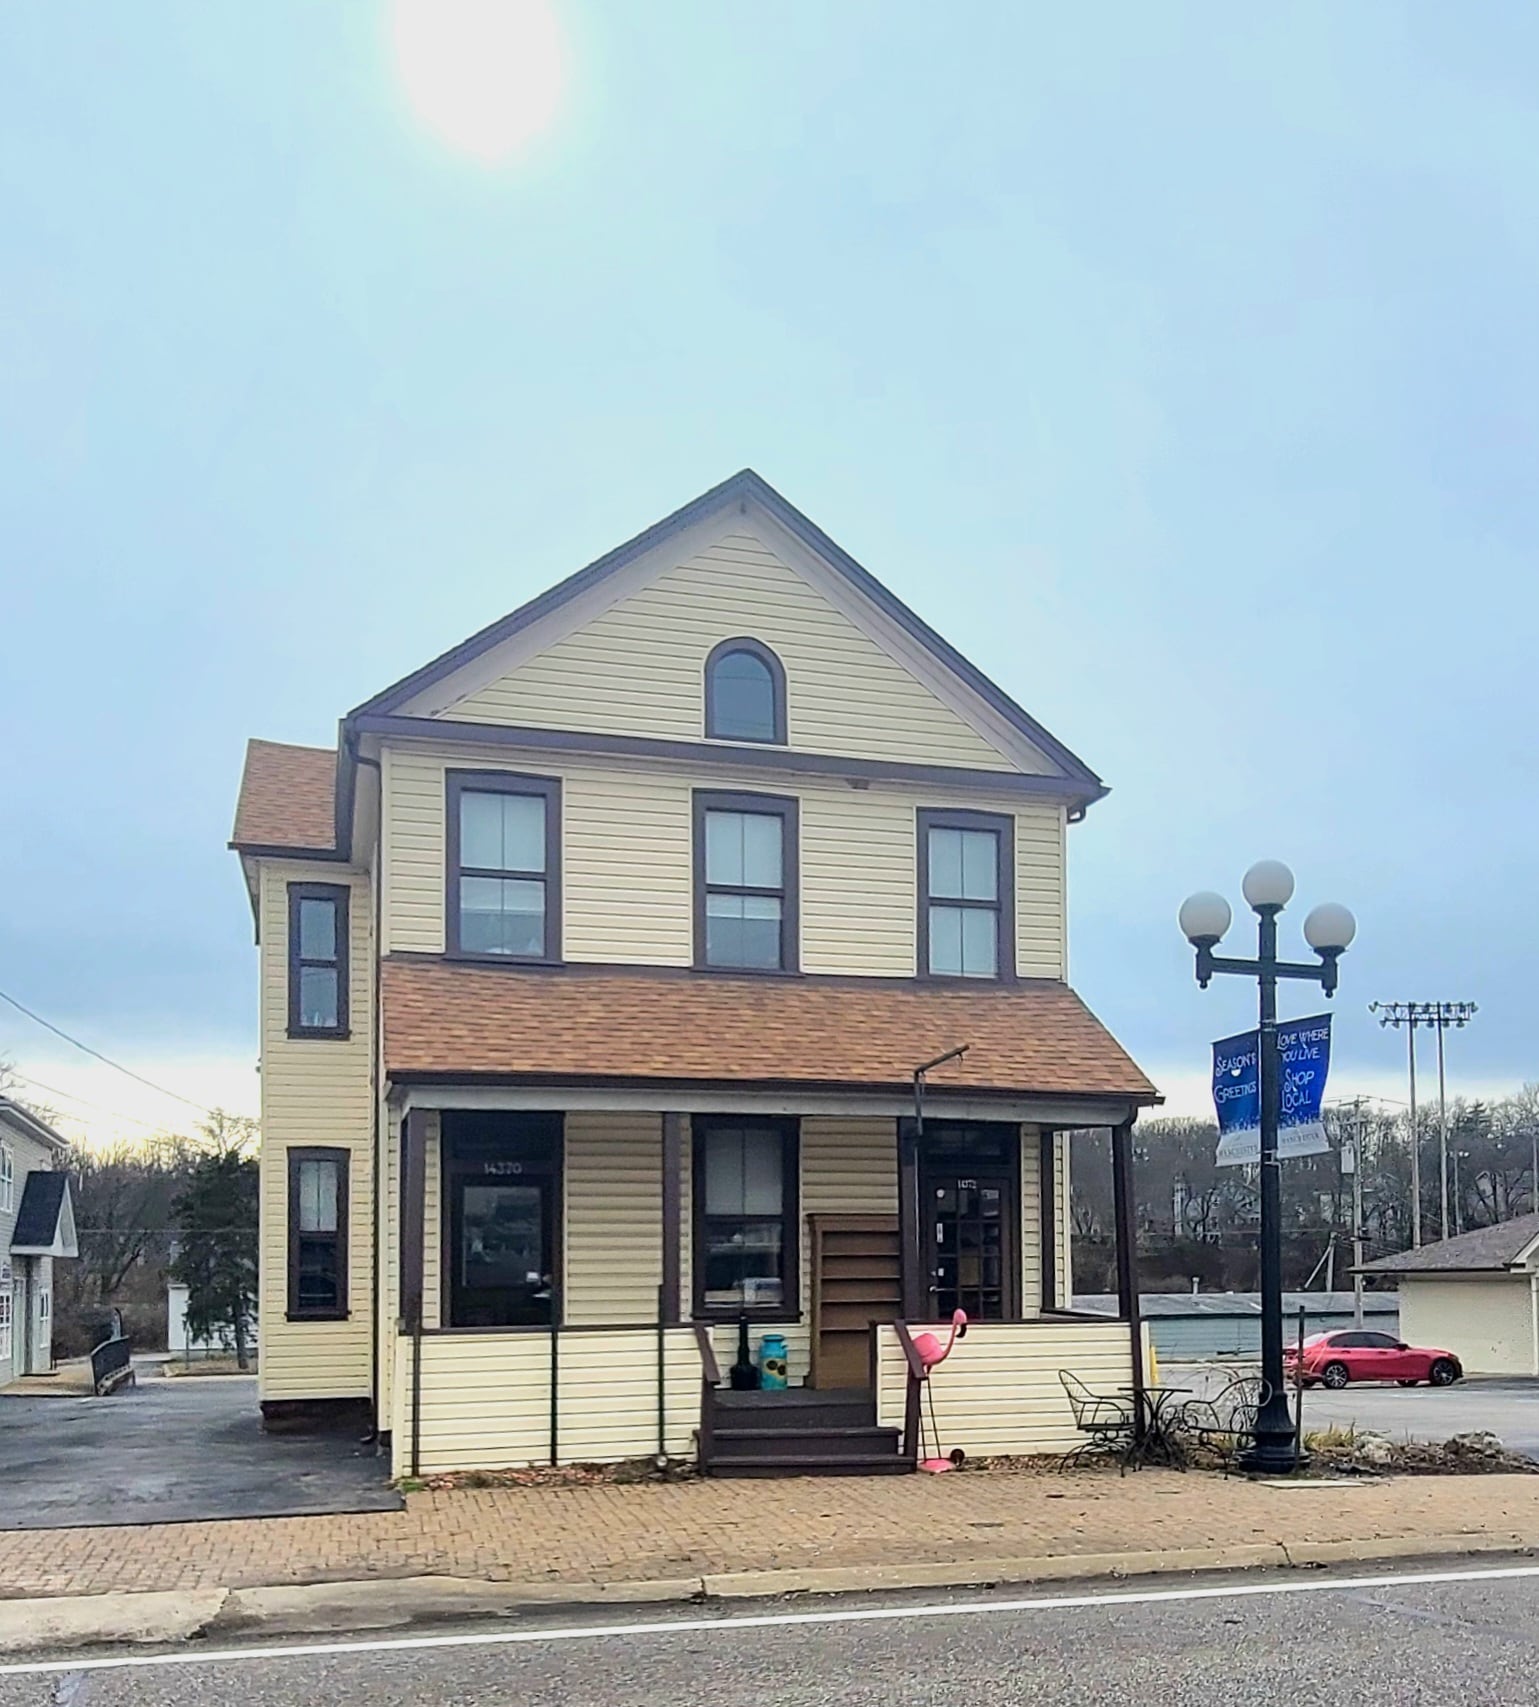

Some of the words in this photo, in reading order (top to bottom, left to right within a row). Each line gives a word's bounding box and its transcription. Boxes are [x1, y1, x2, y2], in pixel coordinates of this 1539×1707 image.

[1276, 1032, 1297, 1050] LOVE
[1299, 1027, 1329, 1043] WHERE
[1281, 1049, 1297, 1063] YOU
[1298, 1047, 1320, 1060] LIVE
[1283, 1068, 1315, 1093] SHOP
[1281, 1089, 1312, 1114] LOCAL
[484, 1161, 522, 1175] 14370
